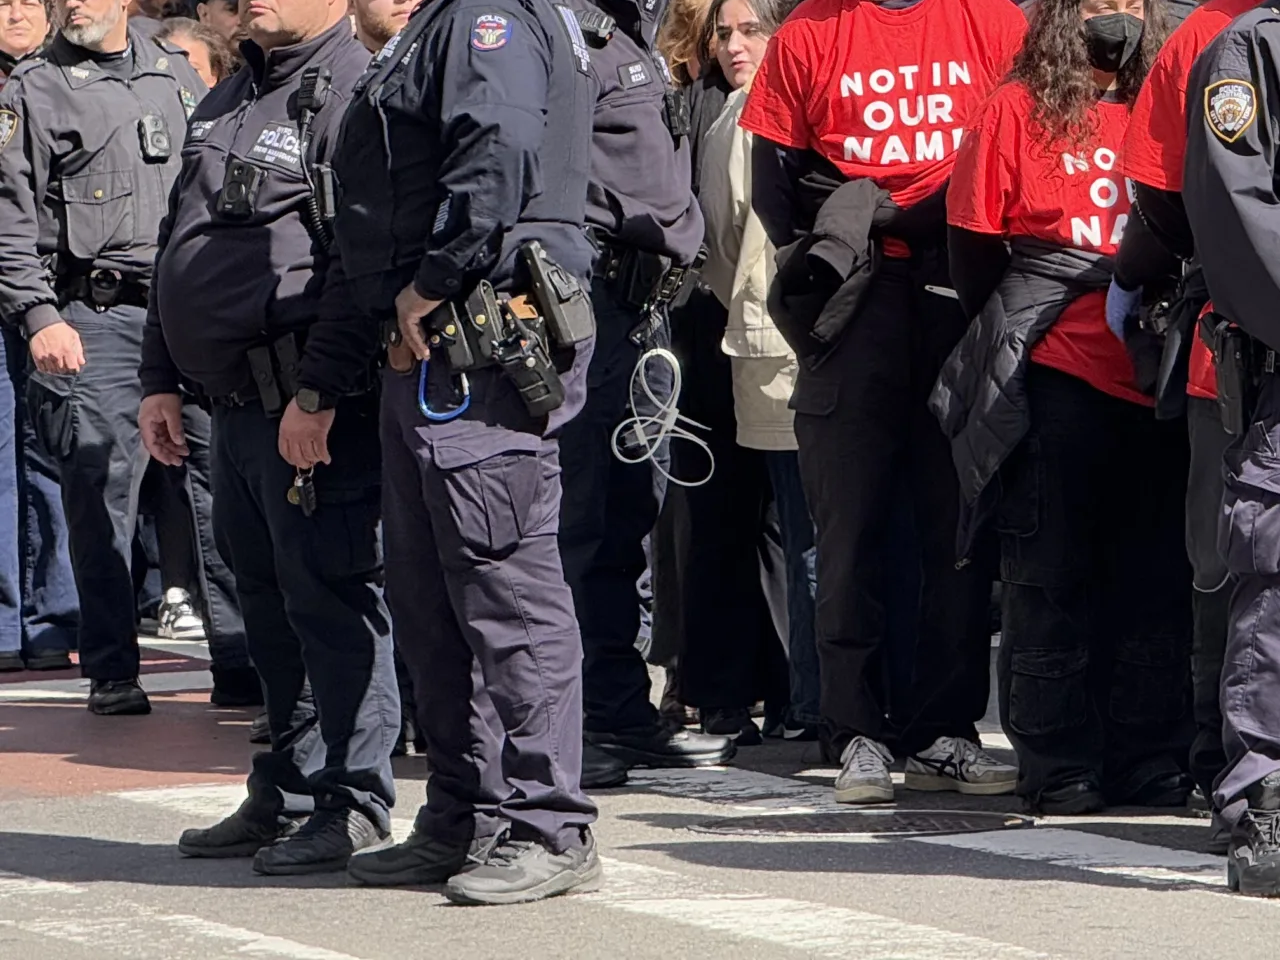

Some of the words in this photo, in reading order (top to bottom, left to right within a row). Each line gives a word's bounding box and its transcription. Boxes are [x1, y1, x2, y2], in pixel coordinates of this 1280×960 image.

[477, 14, 508, 25] POLICE
[840, 65, 919, 97] NOT
[932, 60, 971, 87] IN
[1219, 85, 1243, 94] POLICE
[863, 93, 953, 131] OUR
[1062, 147, 1116, 175] NO
